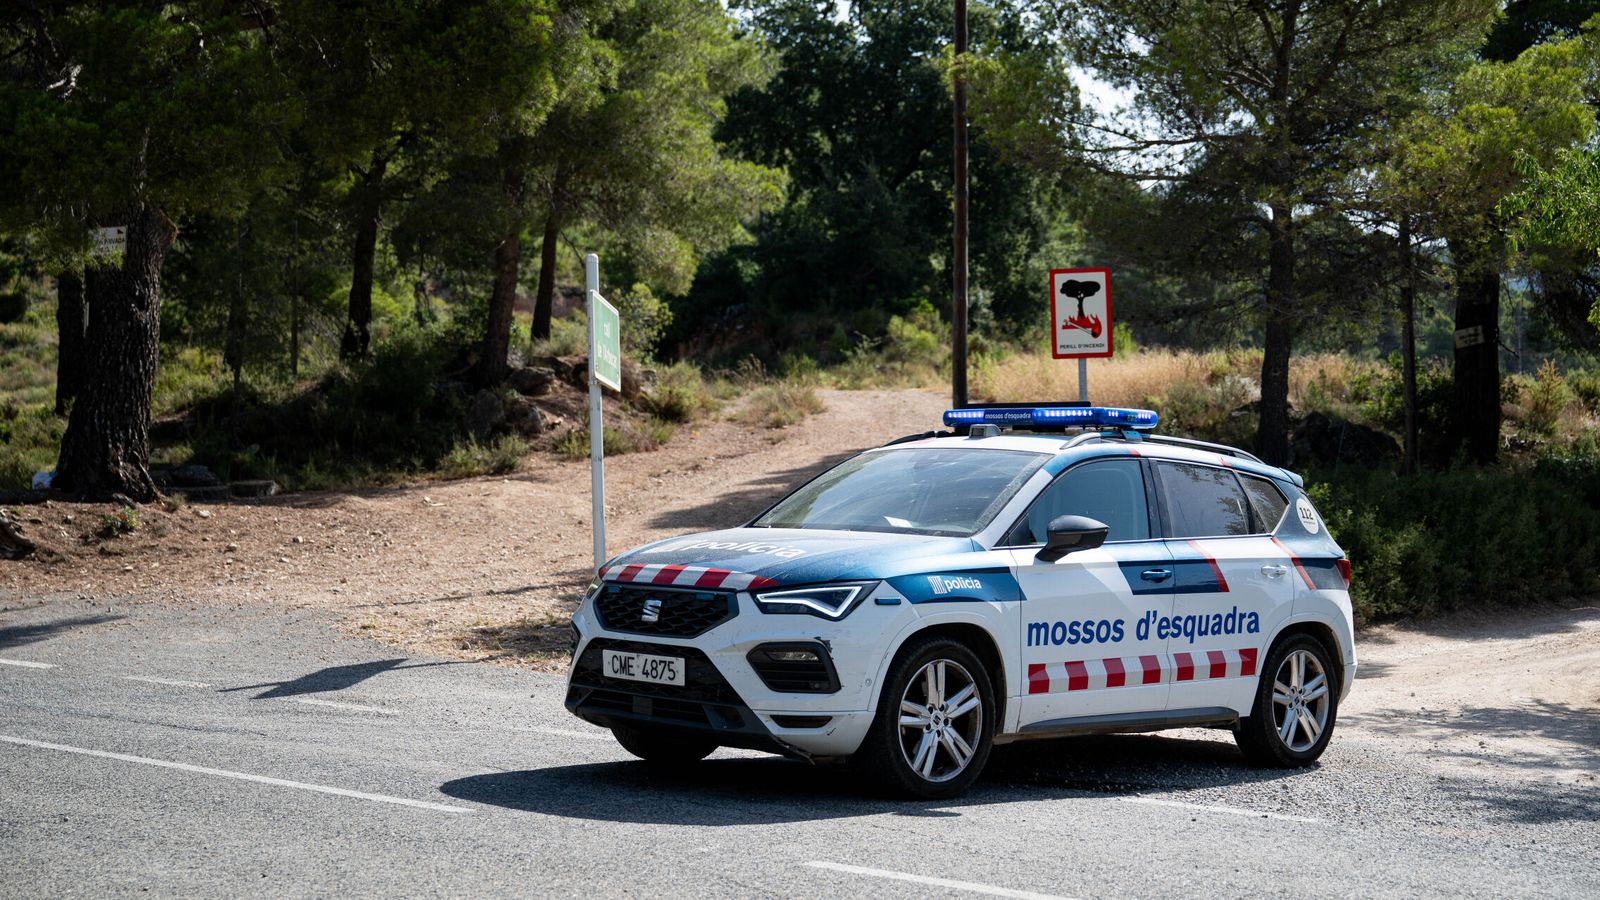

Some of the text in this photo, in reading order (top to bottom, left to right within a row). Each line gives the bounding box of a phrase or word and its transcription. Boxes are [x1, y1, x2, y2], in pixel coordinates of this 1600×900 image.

[1004, 412, 1031, 420] d'esquadra
[1299, 507, 1314, 520] 112
[682, 540, 807, 558] policia
[944, 576, 982, 593] policia
[1027, 605, 1260, 647] mossos d'esquadra
[611, 654, 676, 681] CME 4875
